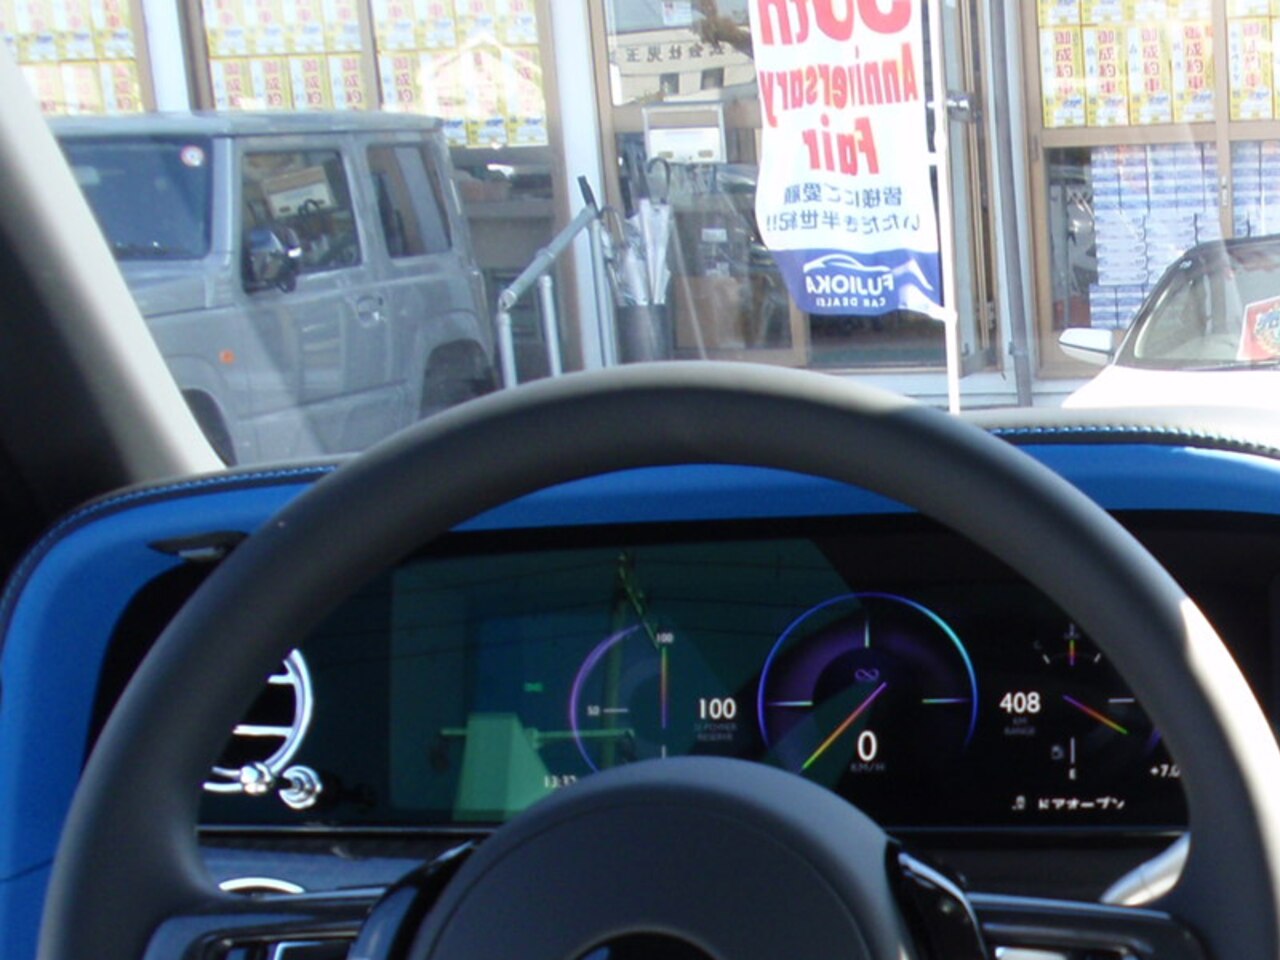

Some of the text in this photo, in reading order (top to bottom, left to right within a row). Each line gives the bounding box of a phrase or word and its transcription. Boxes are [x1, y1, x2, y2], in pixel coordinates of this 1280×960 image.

[699, 698, 737, 719] 100
[1000, 691, 1041, 713] 408
[857, 730, 878, 762] 0
[1037, 796, 1125, 810] ドアオープン
